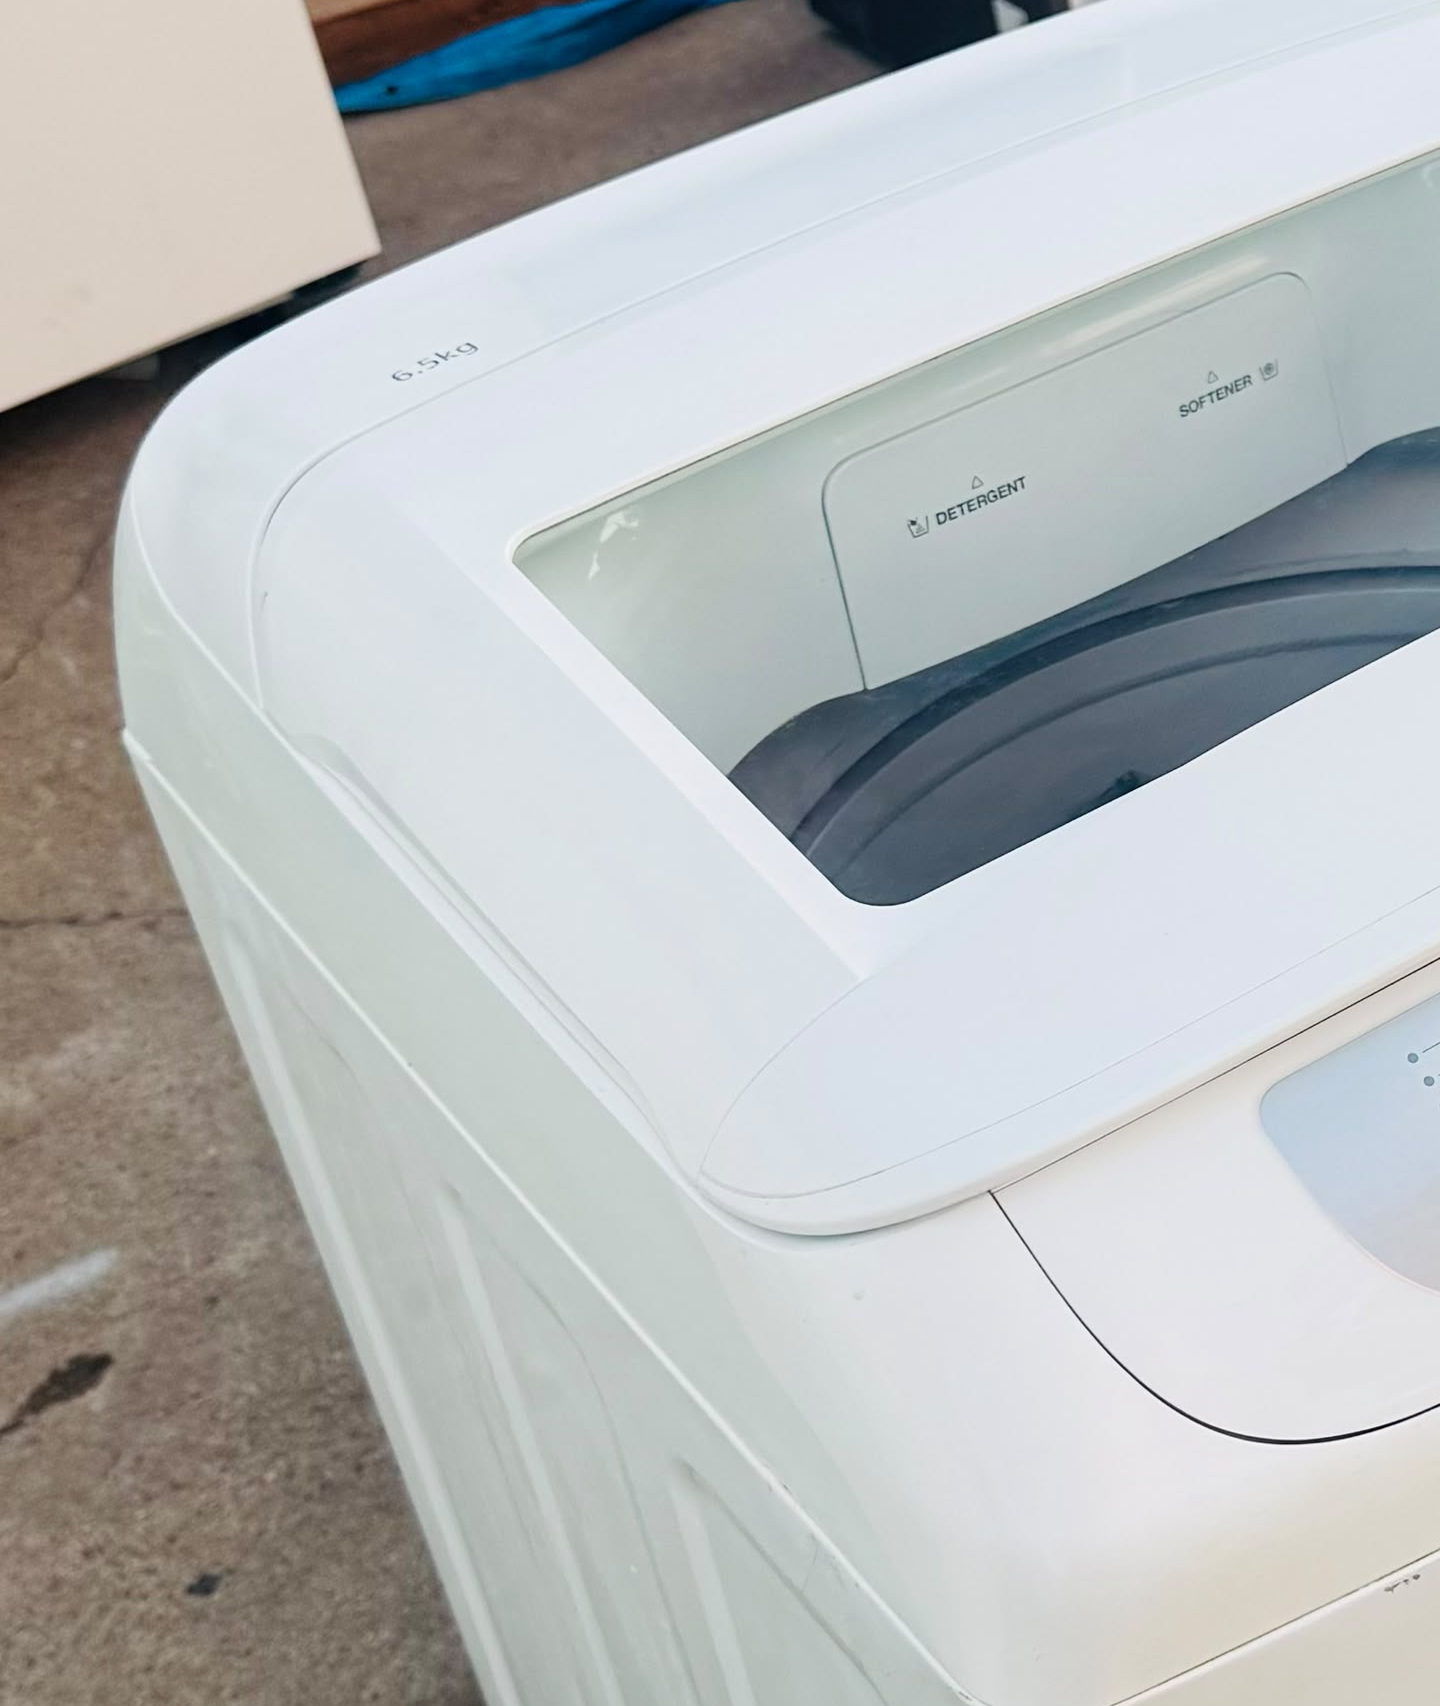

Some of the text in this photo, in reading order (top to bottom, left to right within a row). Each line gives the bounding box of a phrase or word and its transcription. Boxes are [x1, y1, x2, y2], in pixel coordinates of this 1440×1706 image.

[391, 341, 479, 382] 6.5kg
[1179, 374, 1254, 418] SOFTENER
[935, 475, 1026, 526] DETERGENT
